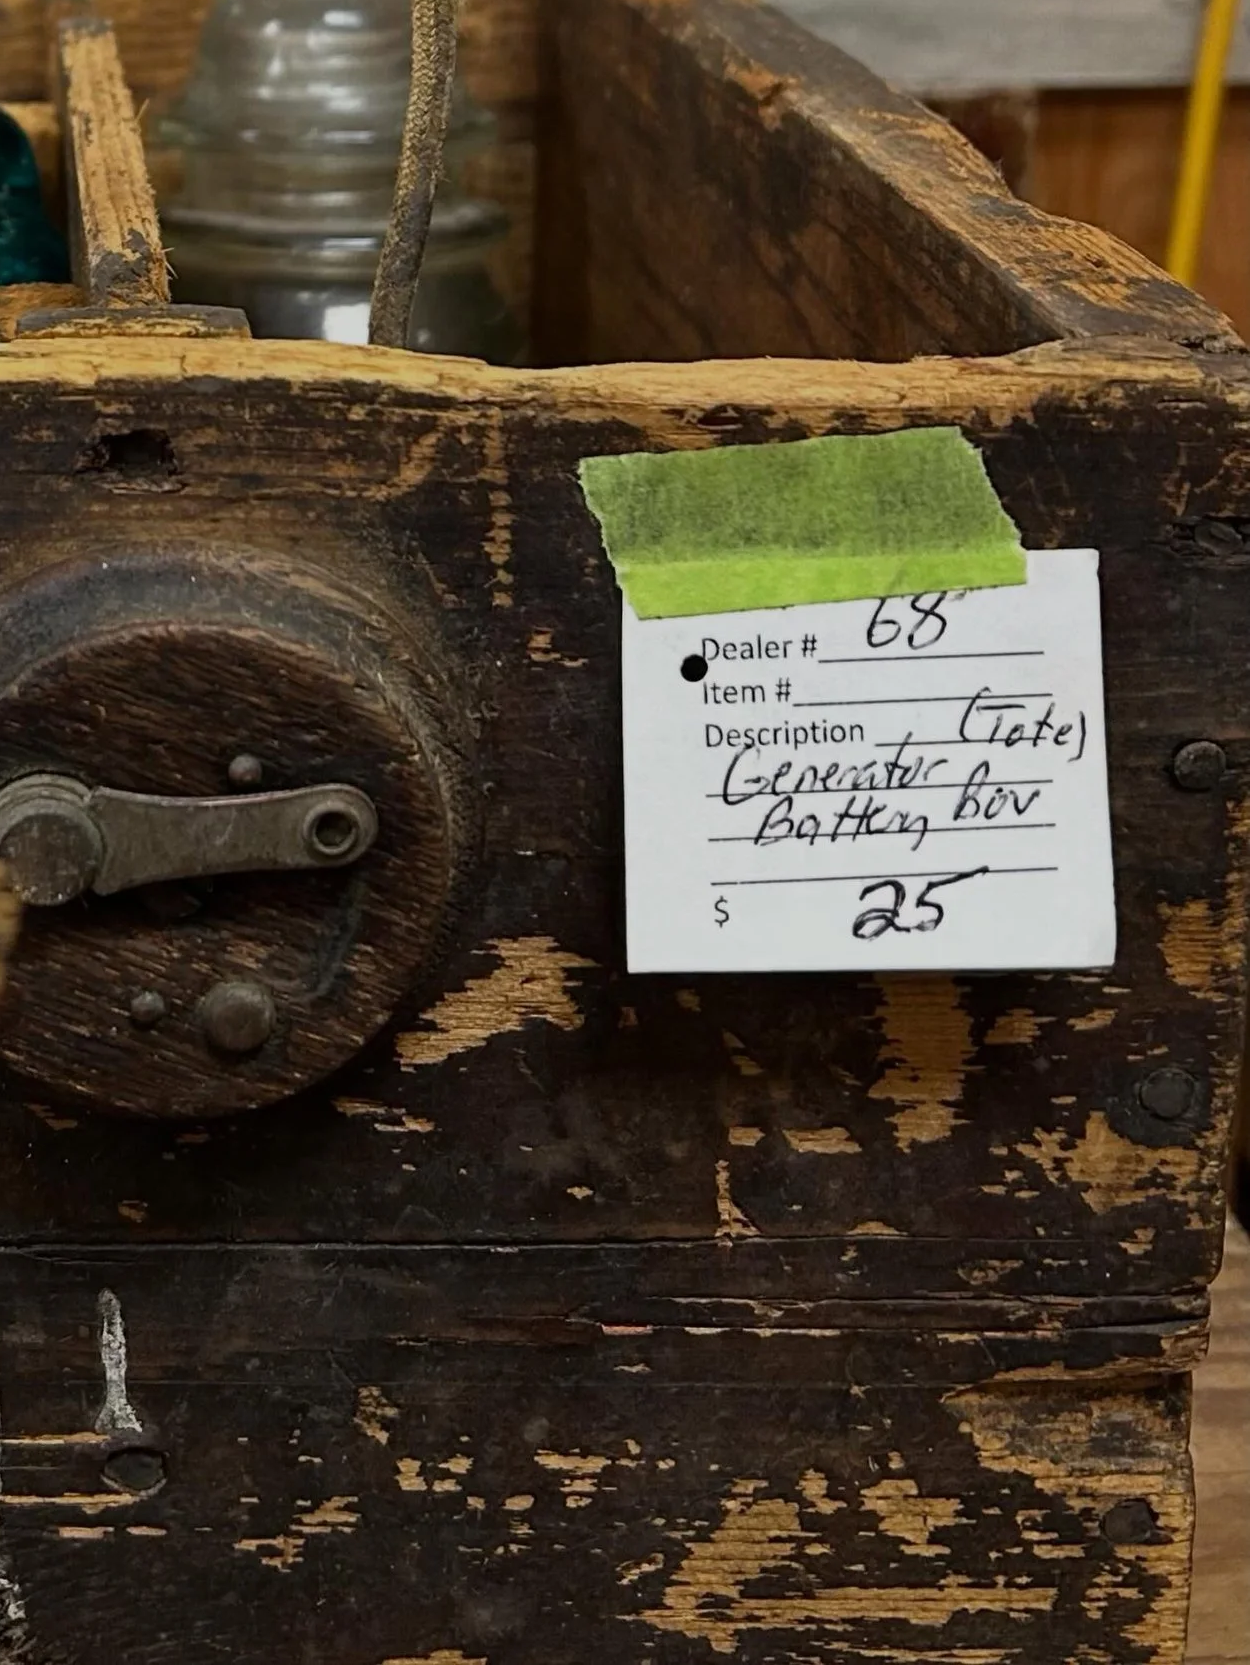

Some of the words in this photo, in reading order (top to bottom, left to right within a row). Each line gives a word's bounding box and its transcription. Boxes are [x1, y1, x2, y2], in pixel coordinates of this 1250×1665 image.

[701, 634, 793, 661] Dealer
[801, 634, 818, 656] #
[866, 591, 948, 650] 68
[702, 681, 766, 704] Item
[775, 678, 792, 702] #
[704, 721, 865, 751] Description
[958, 686, 1087, 762] (Tote)
[722, 731, 949, 806] Generator
[713, 896, 731, 928] $
[852, 866, 990, 941] 25
